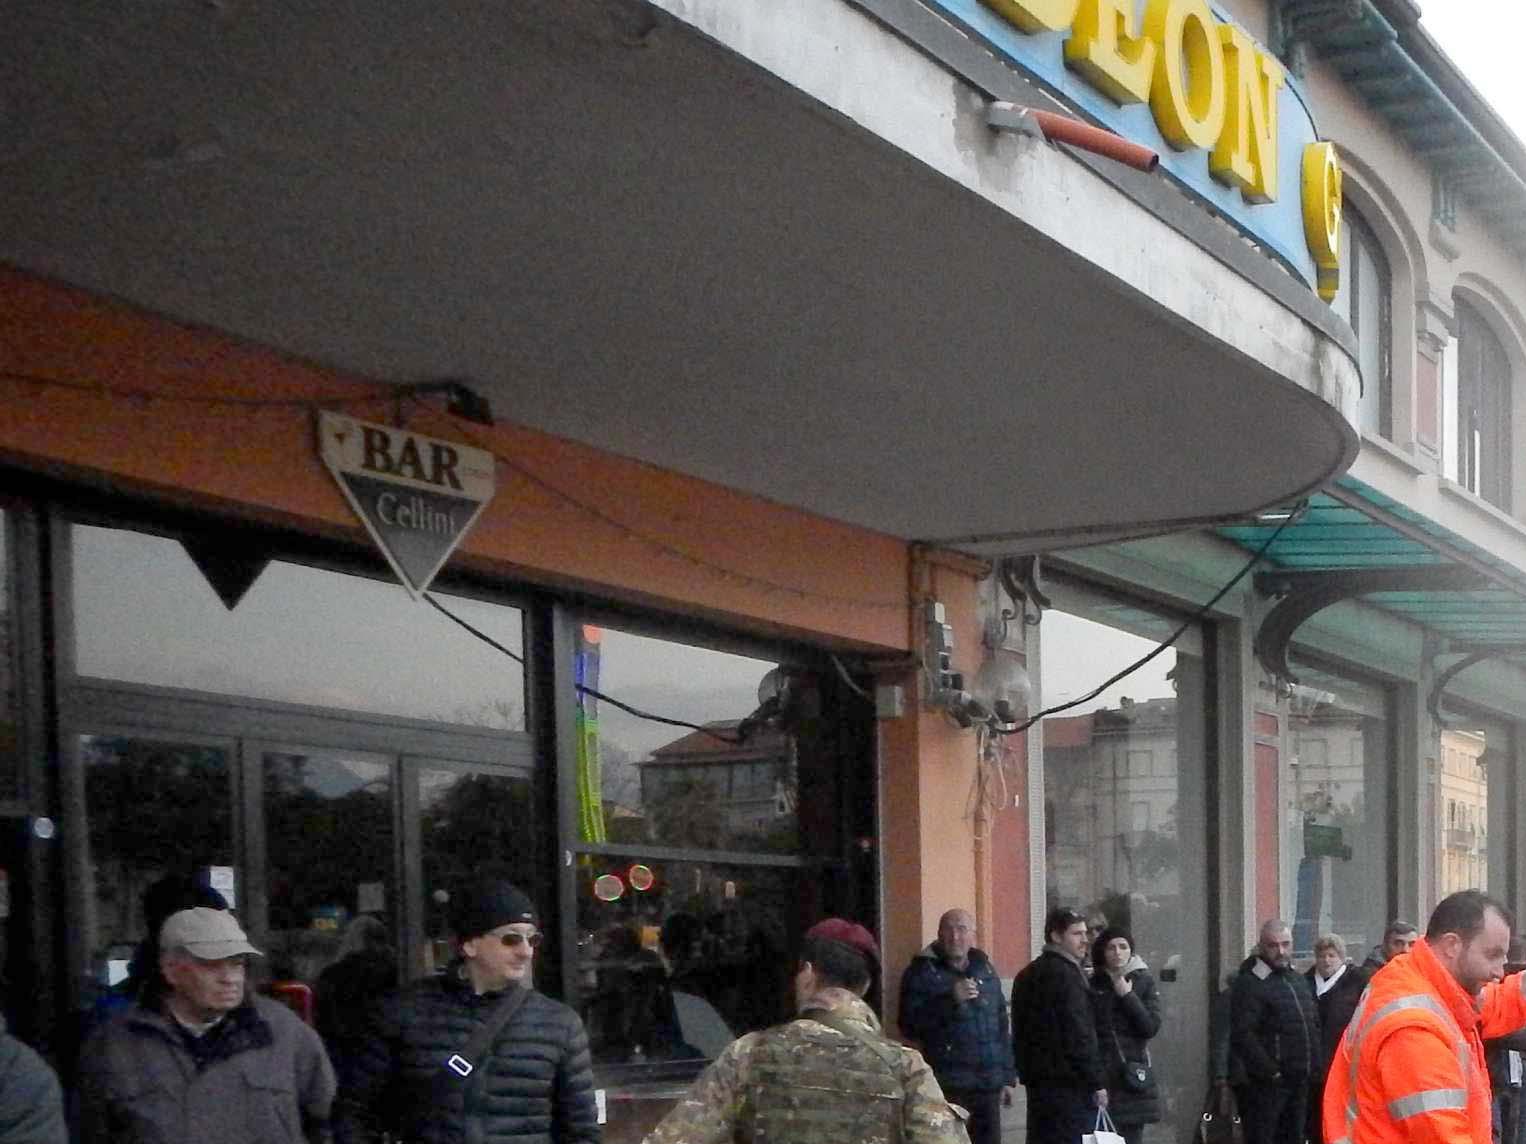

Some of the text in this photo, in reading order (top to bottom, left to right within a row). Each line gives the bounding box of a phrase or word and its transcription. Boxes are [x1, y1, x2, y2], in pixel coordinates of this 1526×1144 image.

[975, 0, 1284, 205] EON
[360, 424, 464, 490] BAR
[376, 491, 457, 536] Cellini
